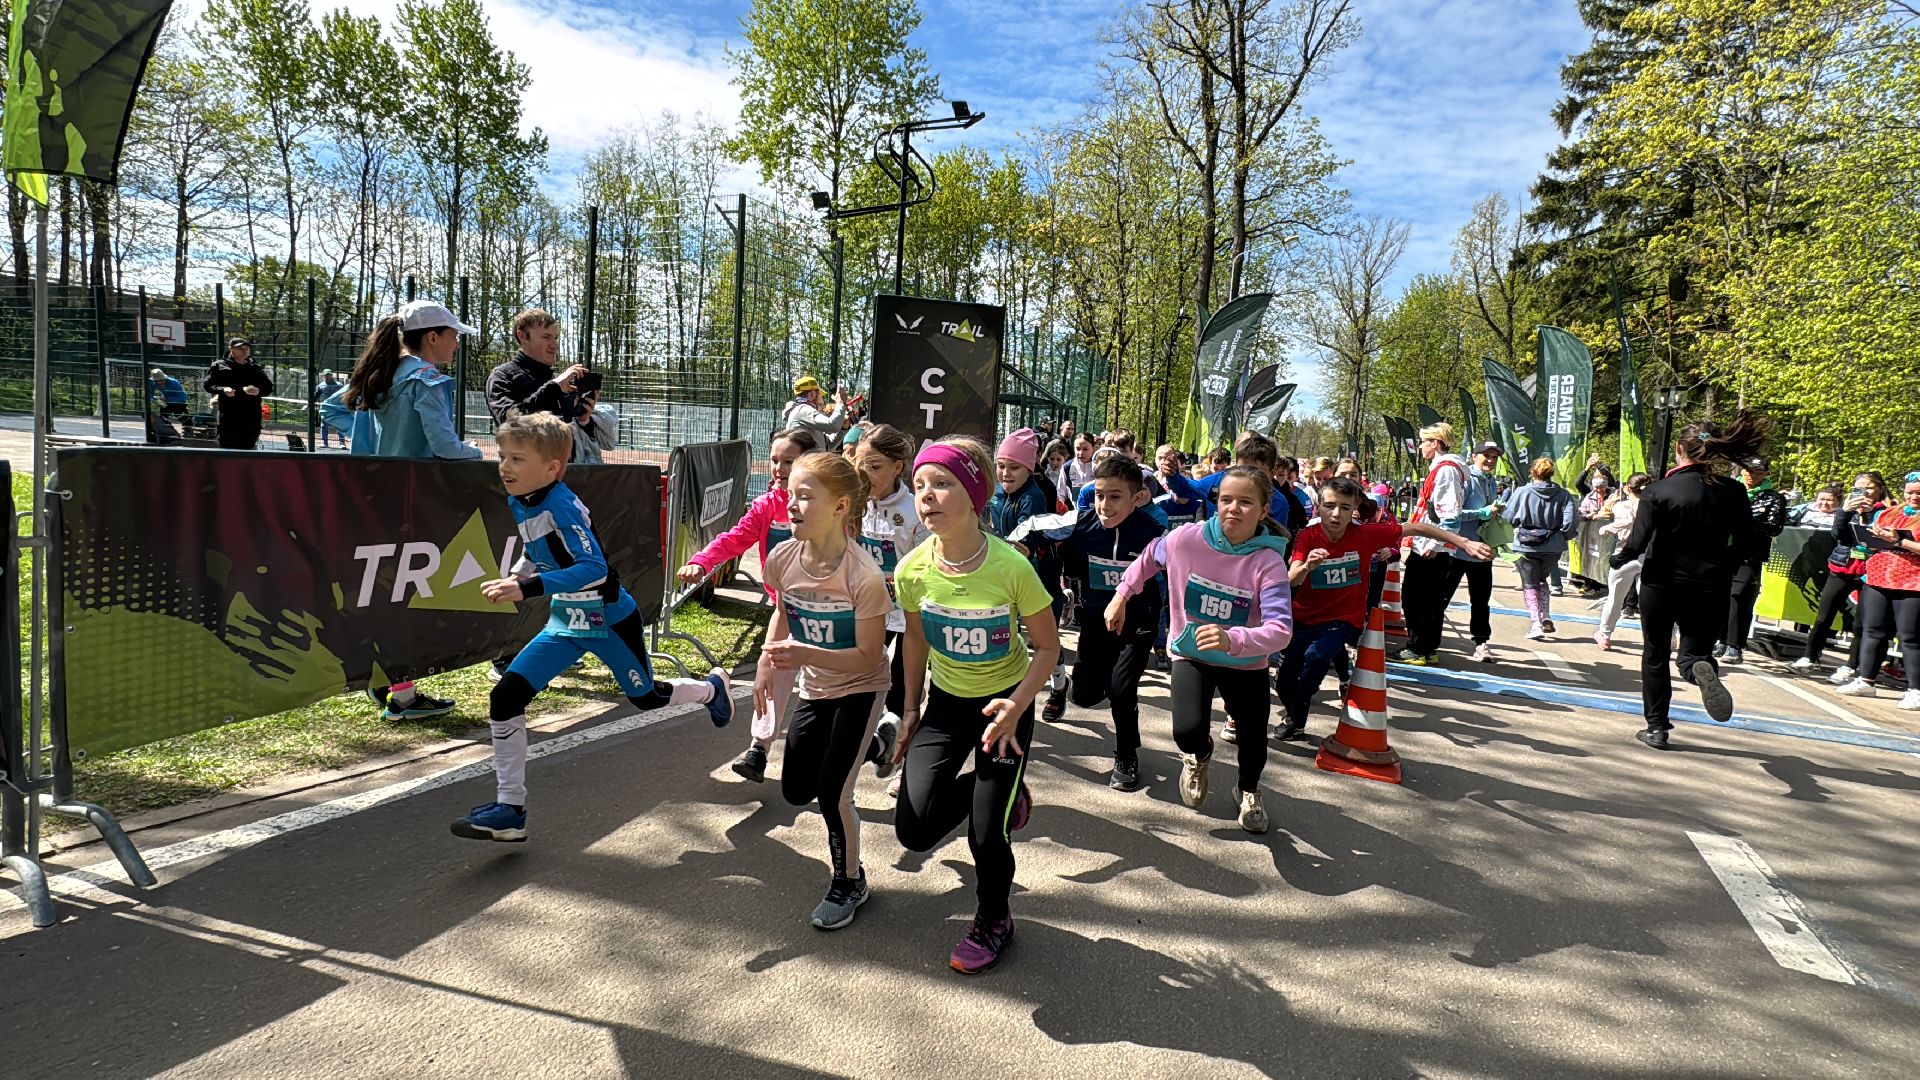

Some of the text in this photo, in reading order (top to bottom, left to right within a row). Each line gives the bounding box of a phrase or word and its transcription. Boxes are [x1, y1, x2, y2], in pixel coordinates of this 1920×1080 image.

[941, 319, 984, 342] TRAIL
[1213, 340, 1228, 371] Команда
[353, 507, 519, 613] TRAI
[1102, 570, 1124, 586] 13
[1323, 567, 1347, 585] 121
[565, 607, 590, 630] 22
[1200, 594, 1233, 620] 159
[800, 616, 835, 644] 137
[942, 626, 988, 655] 129
[991, 632, 1010, 641] 10-13
